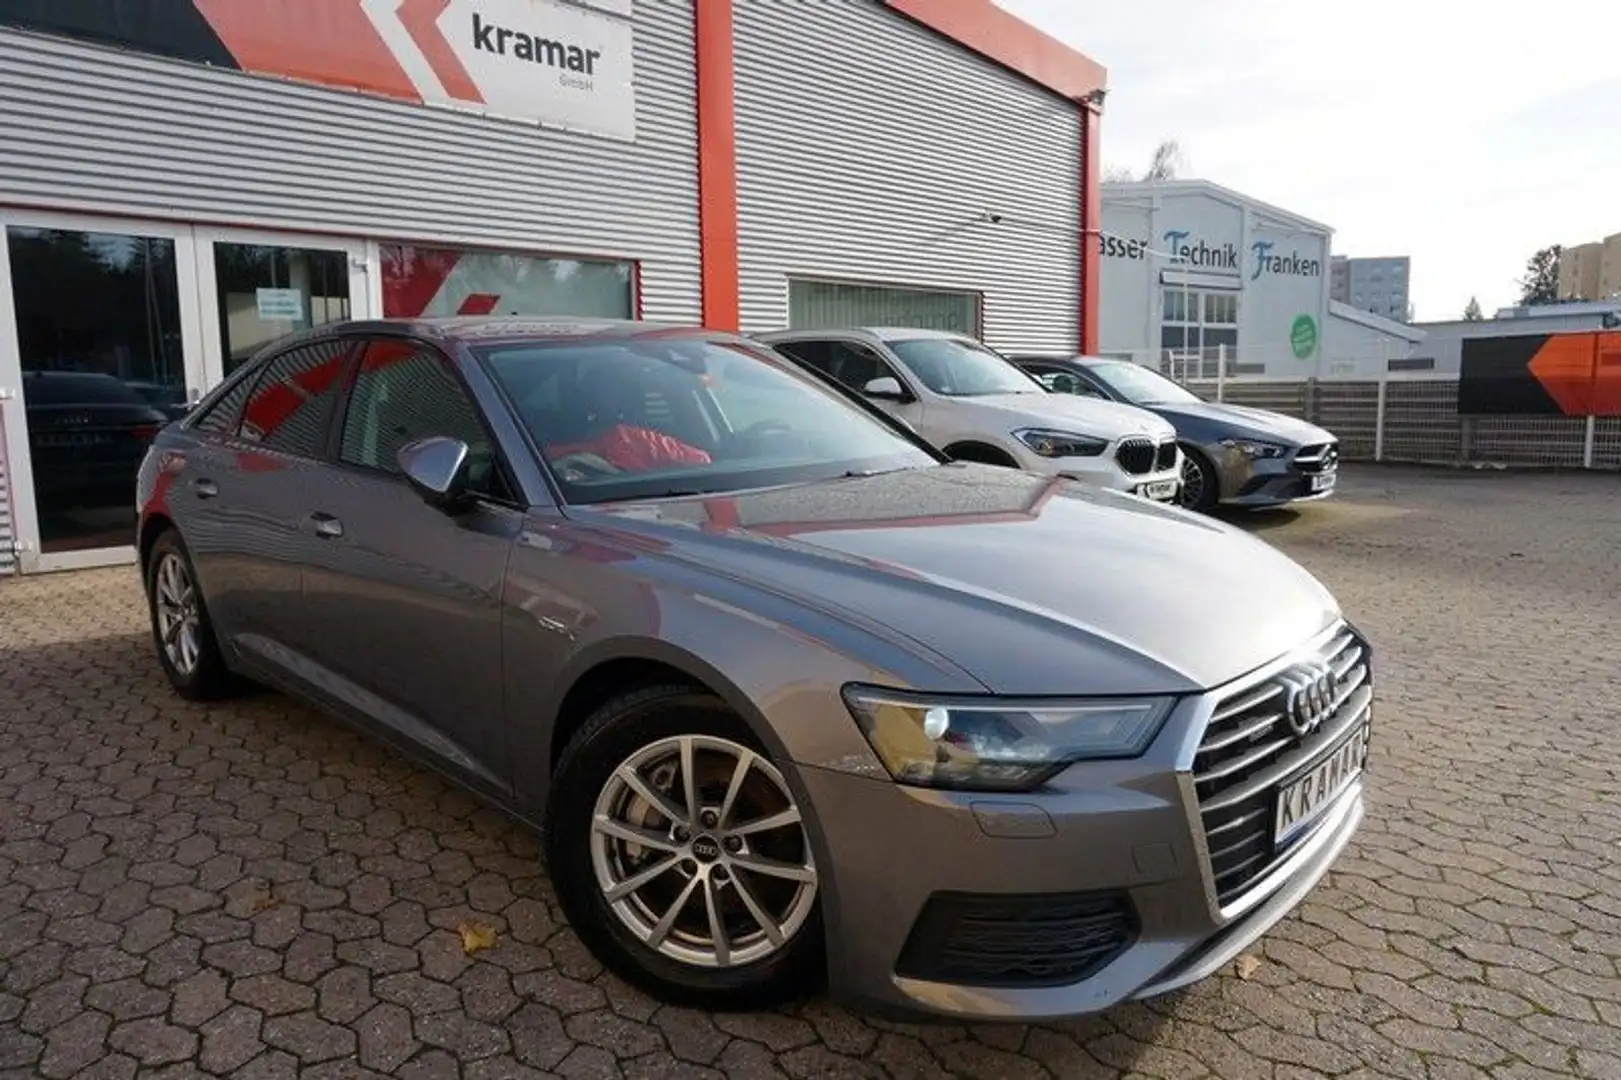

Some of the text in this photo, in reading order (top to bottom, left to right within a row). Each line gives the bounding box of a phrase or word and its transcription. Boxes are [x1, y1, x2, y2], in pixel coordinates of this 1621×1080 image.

[472, 12, 600, 75] kramar
[1163, 231, 1237, 269] Technik
[1251, 241, 1319, 280] Franken
[1282, 734, 1361, 828] KRAMAR
